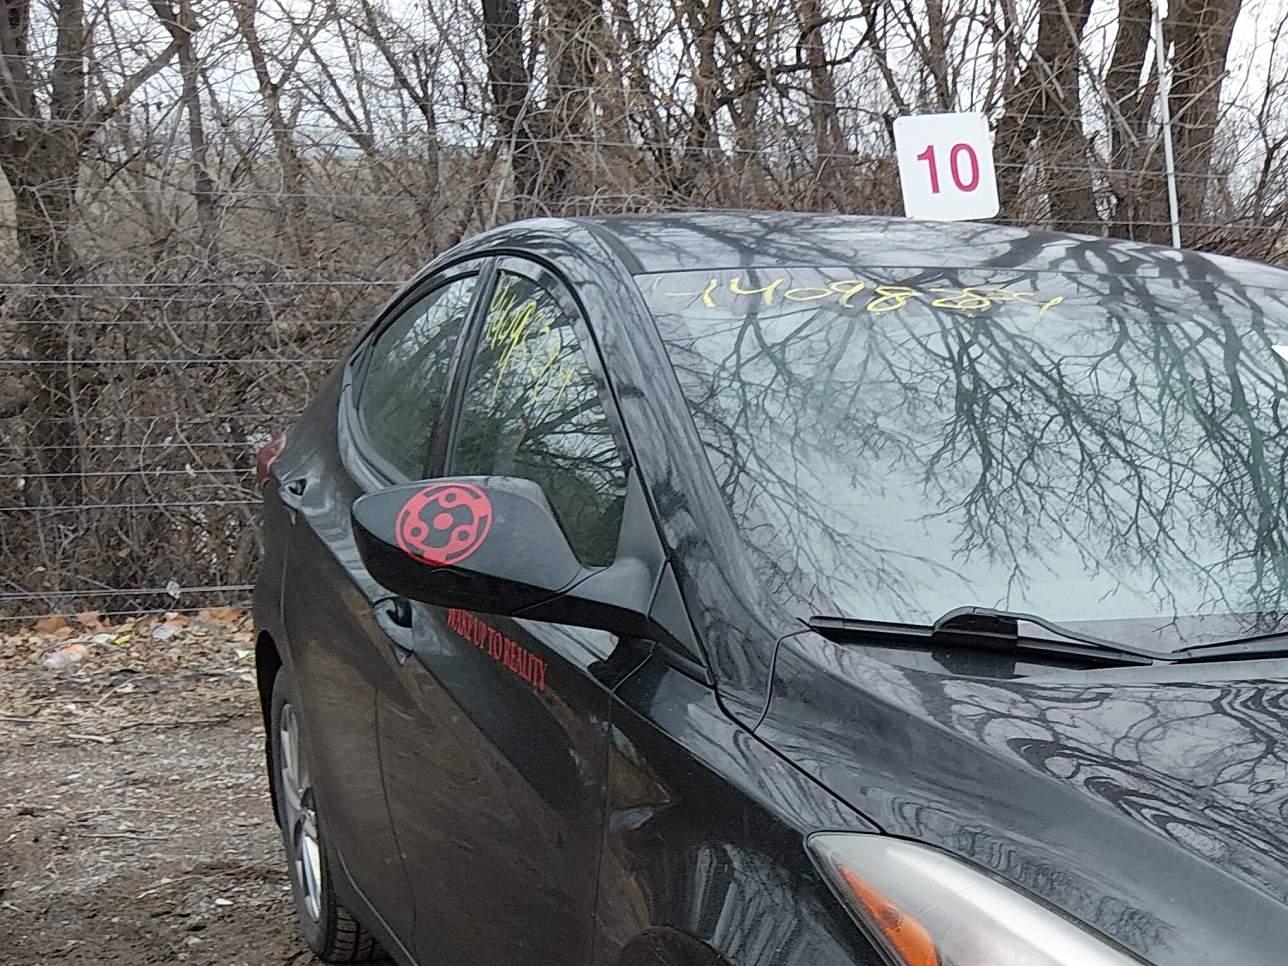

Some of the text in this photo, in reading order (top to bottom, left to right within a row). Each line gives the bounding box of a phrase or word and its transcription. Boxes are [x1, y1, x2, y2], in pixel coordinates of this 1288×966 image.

[916, 143, 980, 194] 10
[473, 617, 487, 650] UP
[487, 626, 503, 661] TO
[503, 637, 549, 692] REALITY
